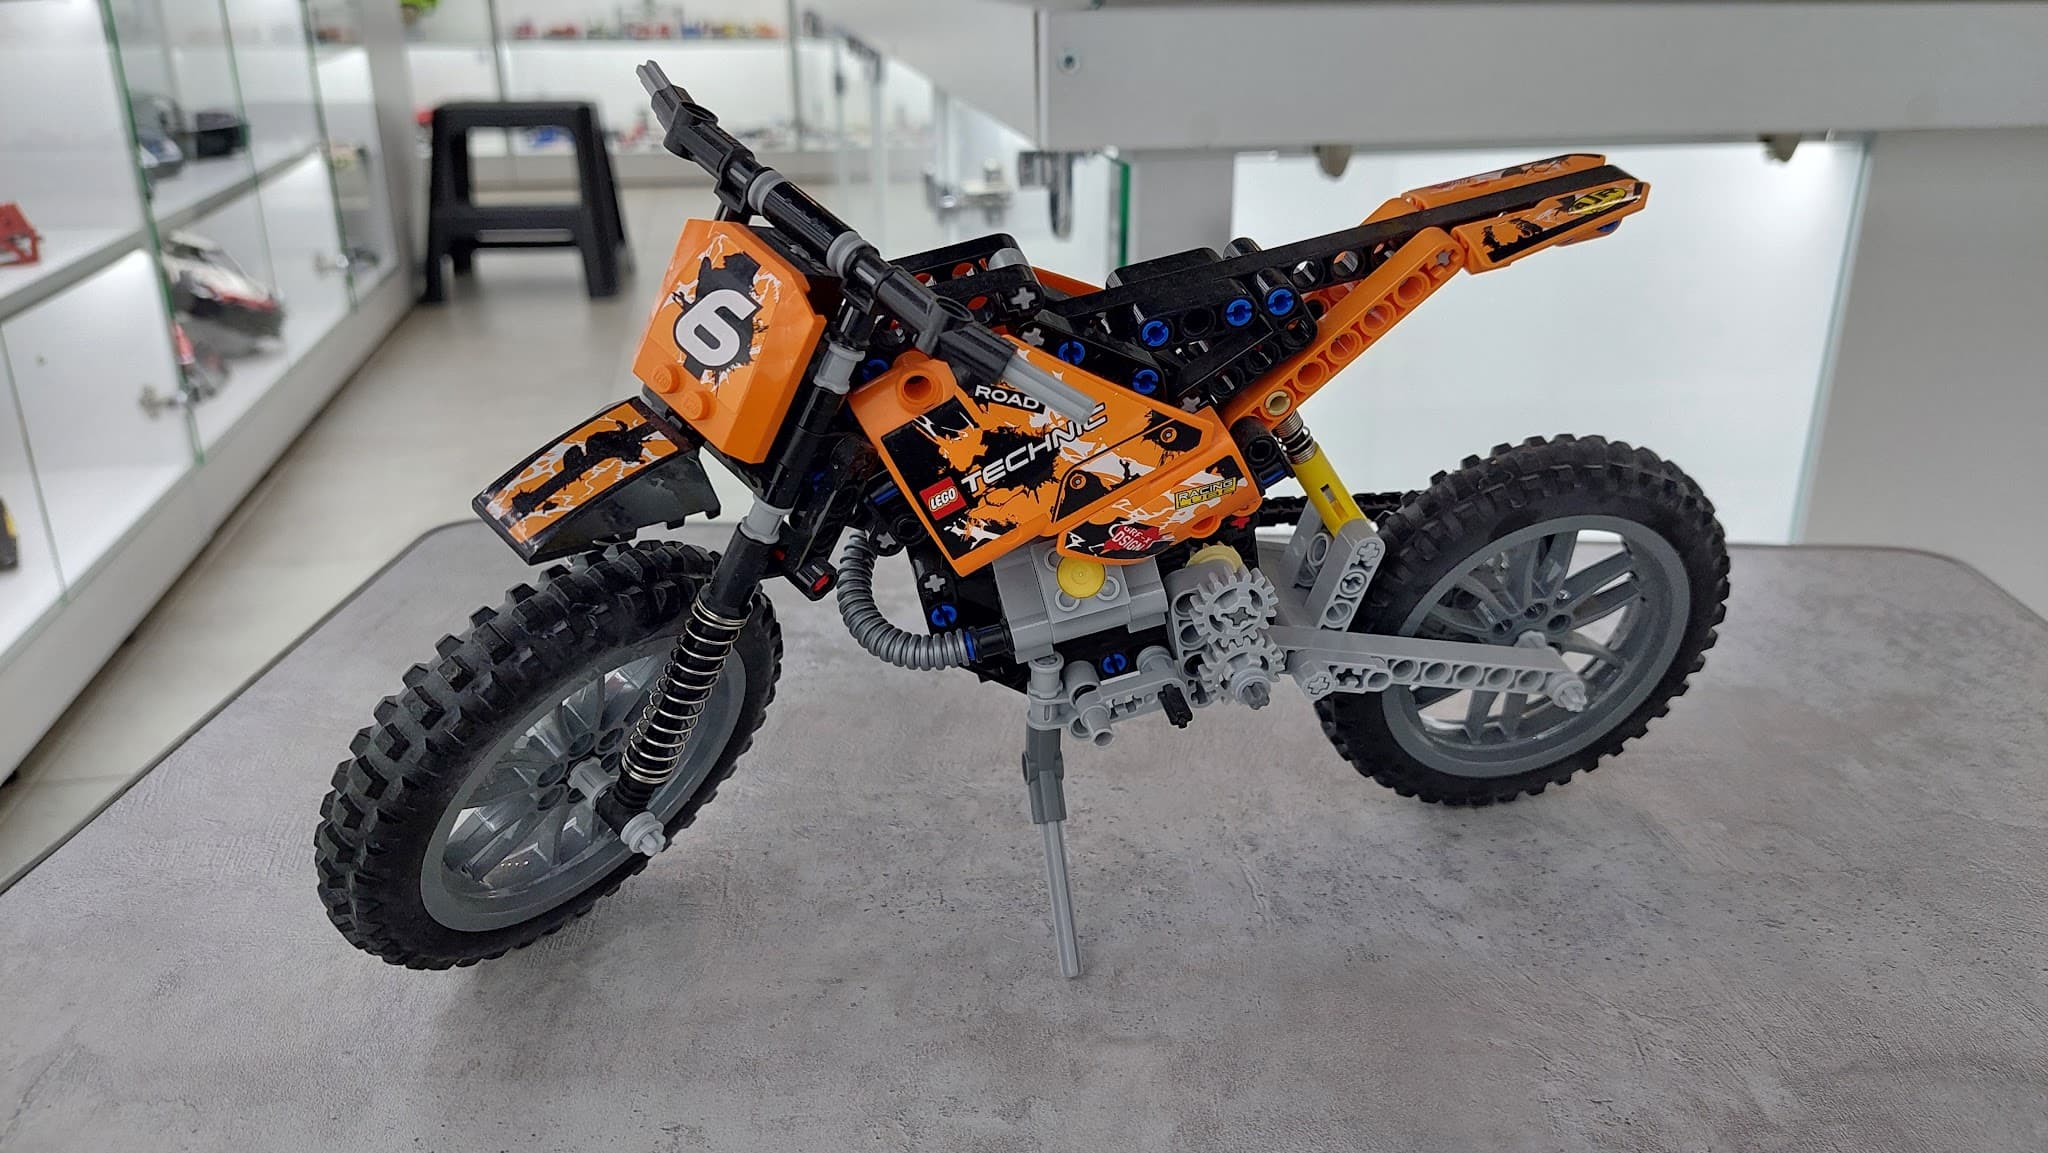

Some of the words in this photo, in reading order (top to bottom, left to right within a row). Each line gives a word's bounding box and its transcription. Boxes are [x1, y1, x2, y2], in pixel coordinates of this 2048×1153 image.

[676, 289, 756, 367] 6
[974, 384, 1040, 410] ROAD
[960, 402, 1107, 493] TECHNIC
[929, 486, 958, 511] LEGO
[1178, 479, 1233, 499] RACING
[1112, 531, 1146, 551] DSIGN
